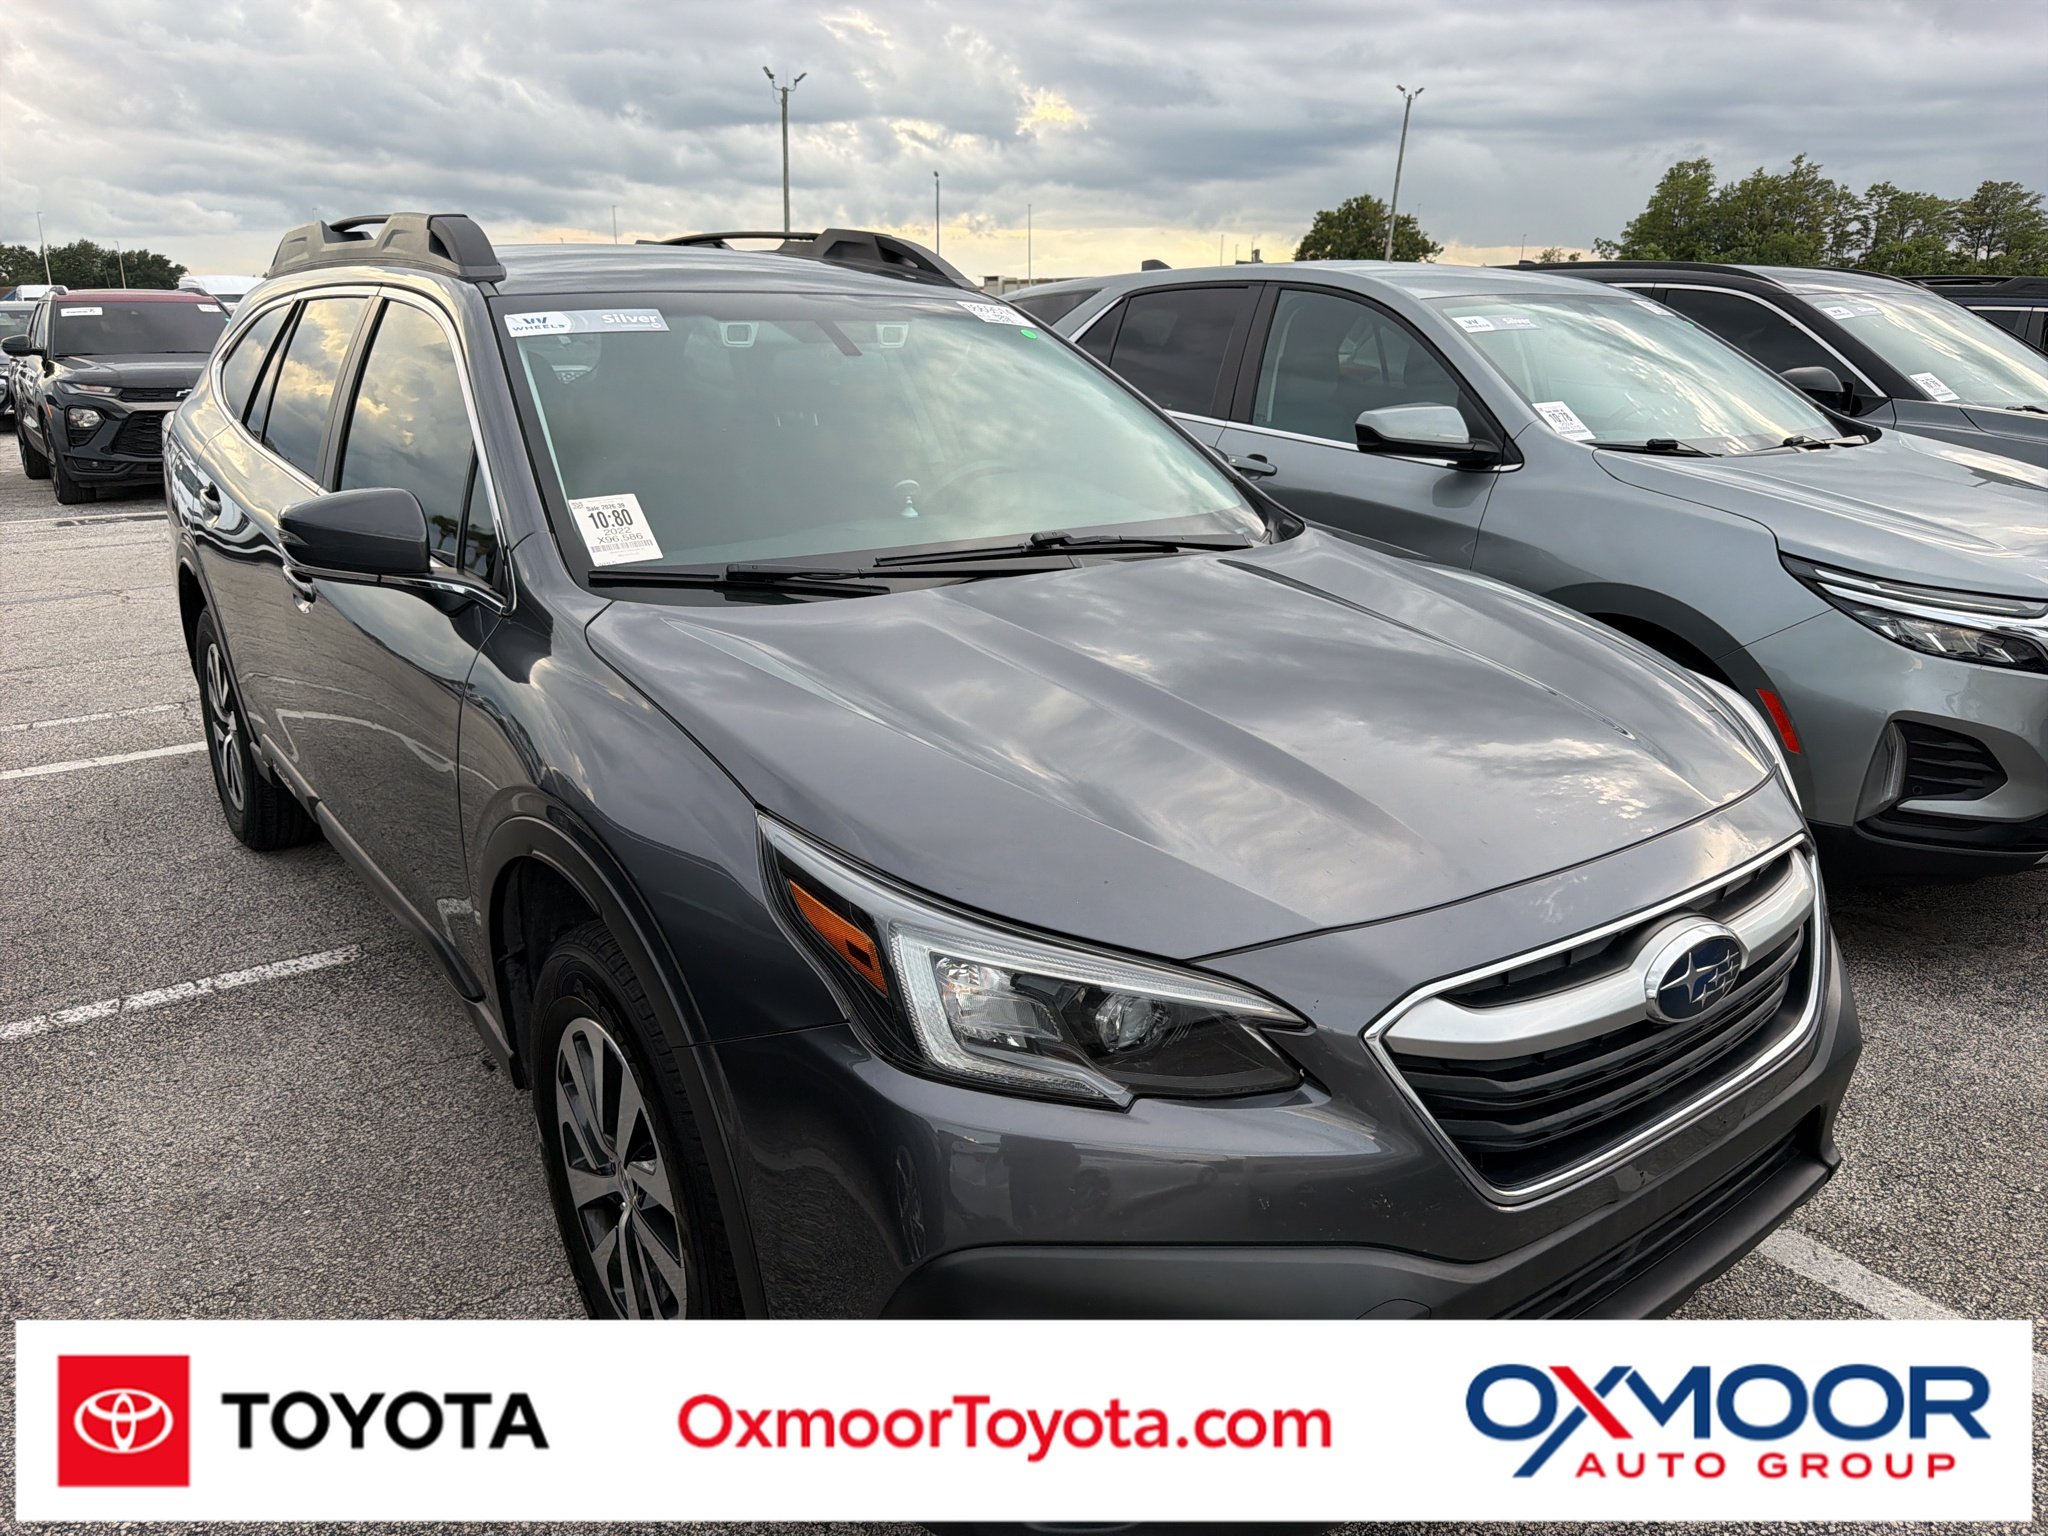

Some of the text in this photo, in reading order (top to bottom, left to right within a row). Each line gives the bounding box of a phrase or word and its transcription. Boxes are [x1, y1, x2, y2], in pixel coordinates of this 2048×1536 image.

[601, 313, 657, 324] Silver
[512, 323, 566, 331] WHEELS
[588, 508, 634, 530] 10:80
[603, 526, 632, 537] 2022
[597, 531, 644, 545] X96,586
